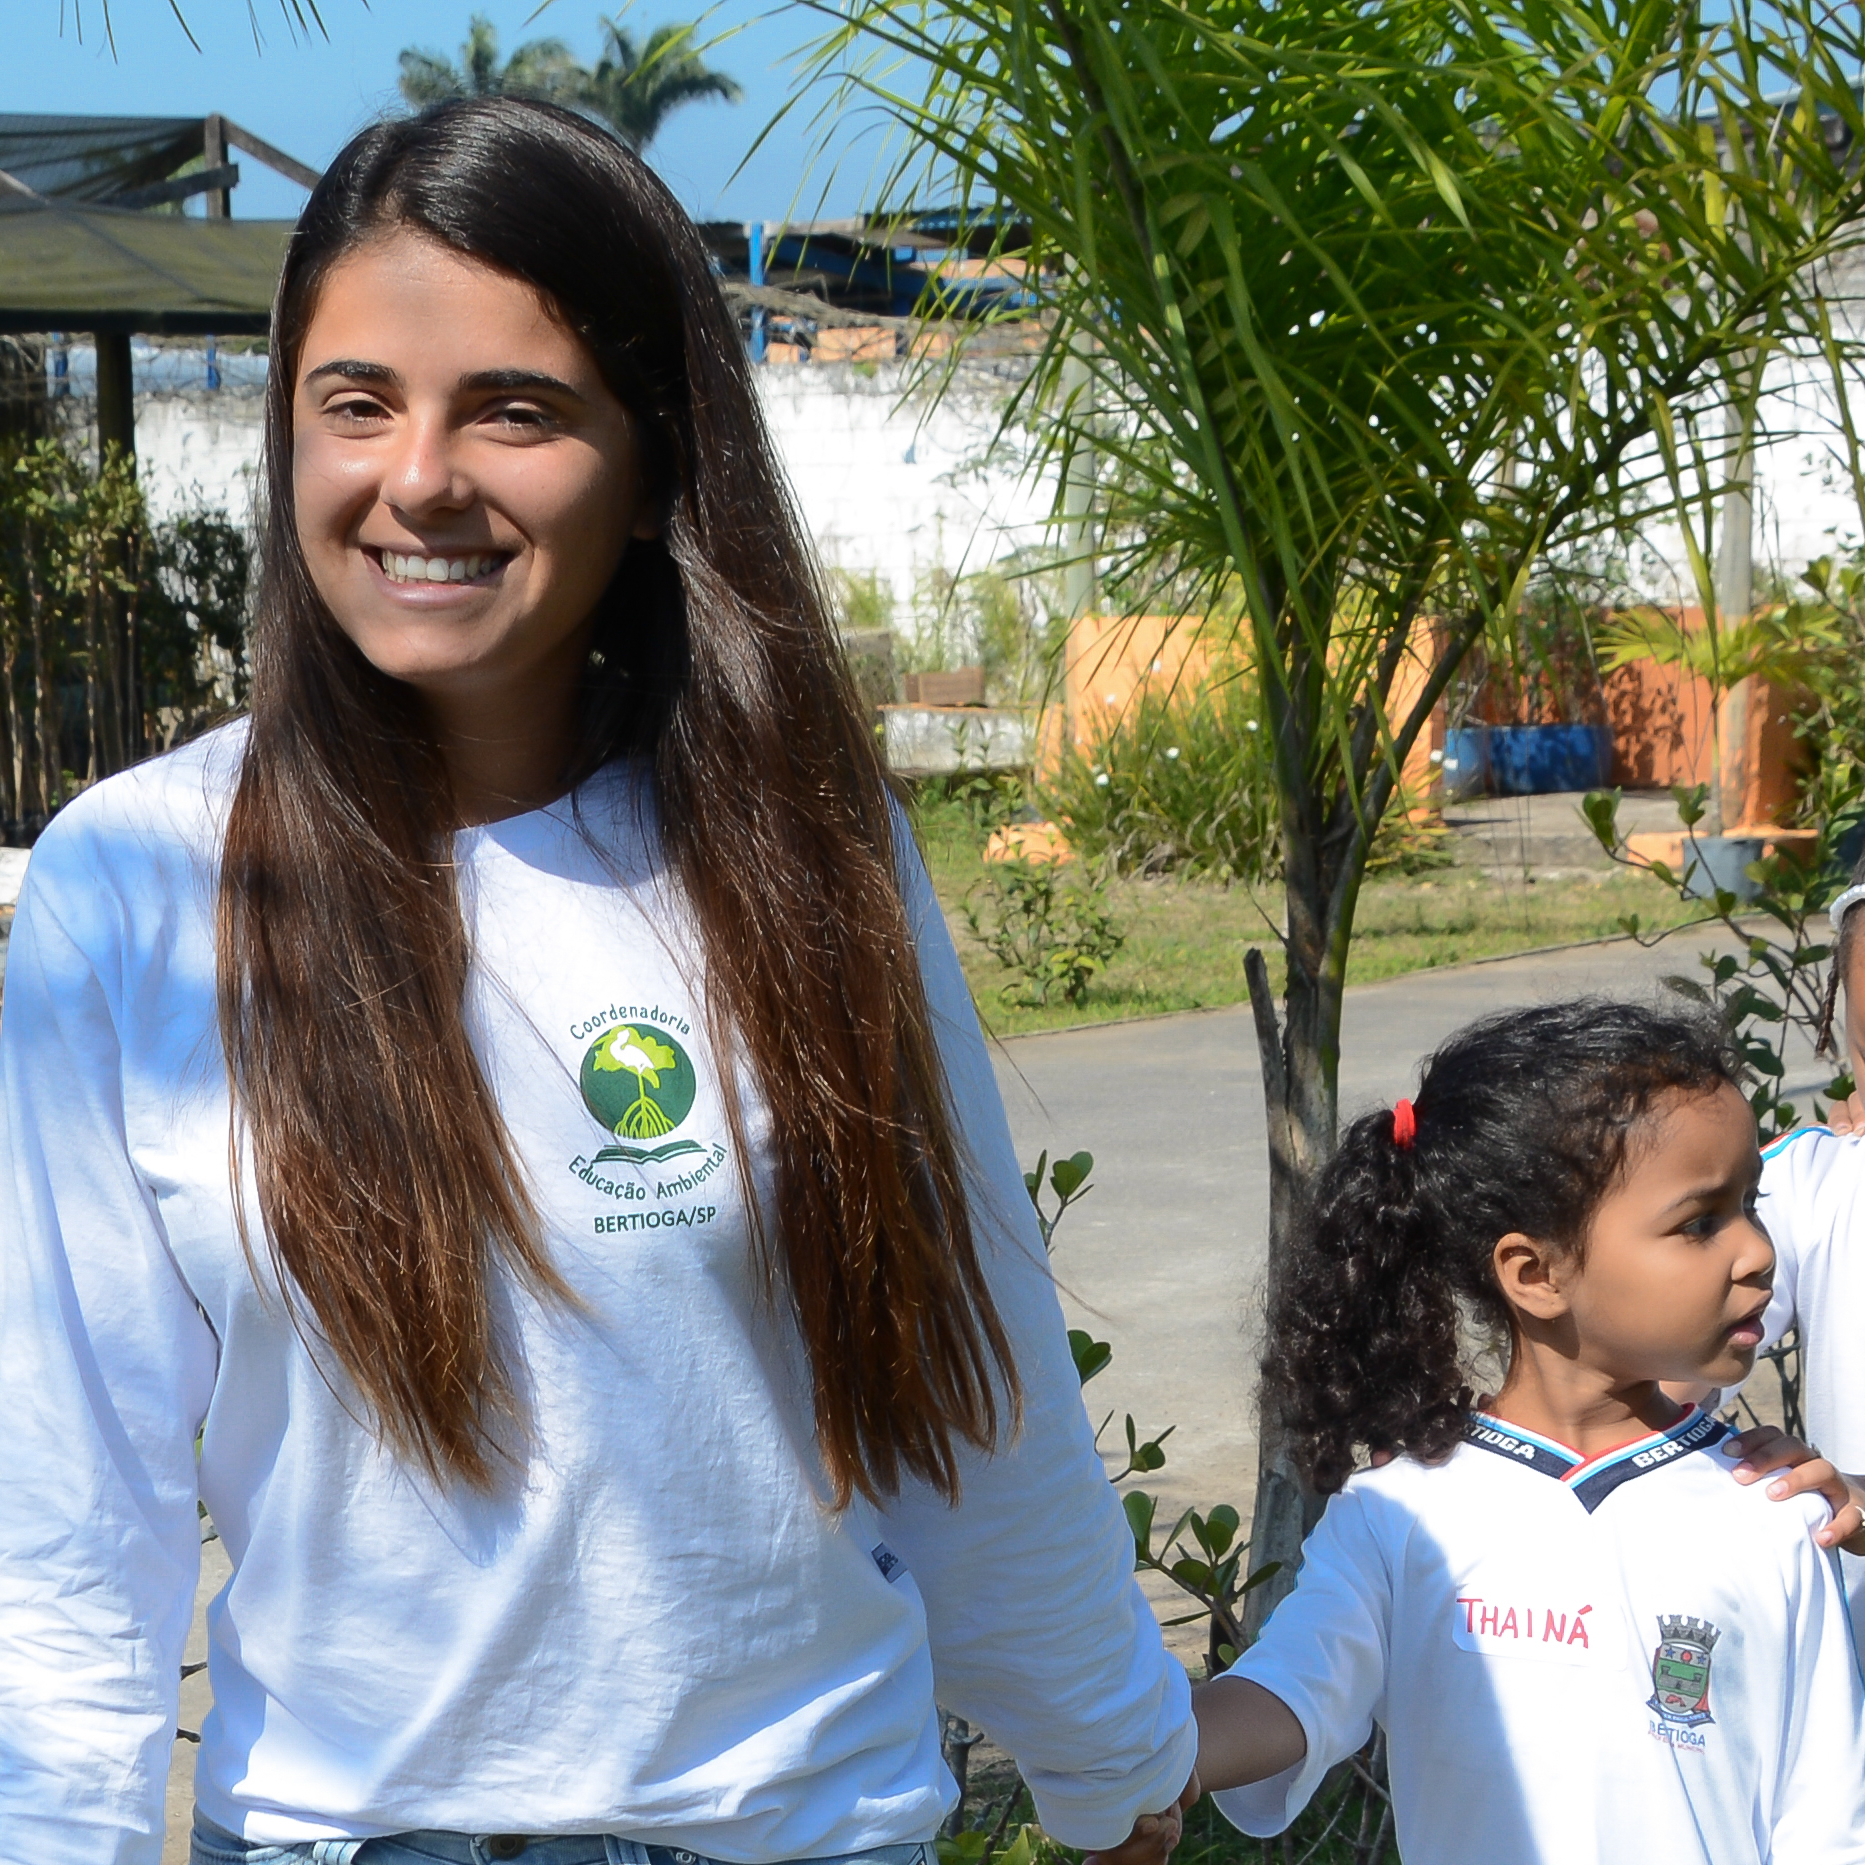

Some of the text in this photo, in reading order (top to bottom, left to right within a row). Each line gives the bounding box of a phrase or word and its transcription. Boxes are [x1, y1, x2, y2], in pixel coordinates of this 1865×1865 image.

[570, 1004, 690, 1039] Coordenadoria
[569, 1143, 728, 1200] Educação Ambiental
[594, 1206, 716, 1233] BERTIOGA/SP
[1631, 1415, 1717, 1469] BERTIOGA
[1455, 1597, 1593, 1650] THAINÁ
